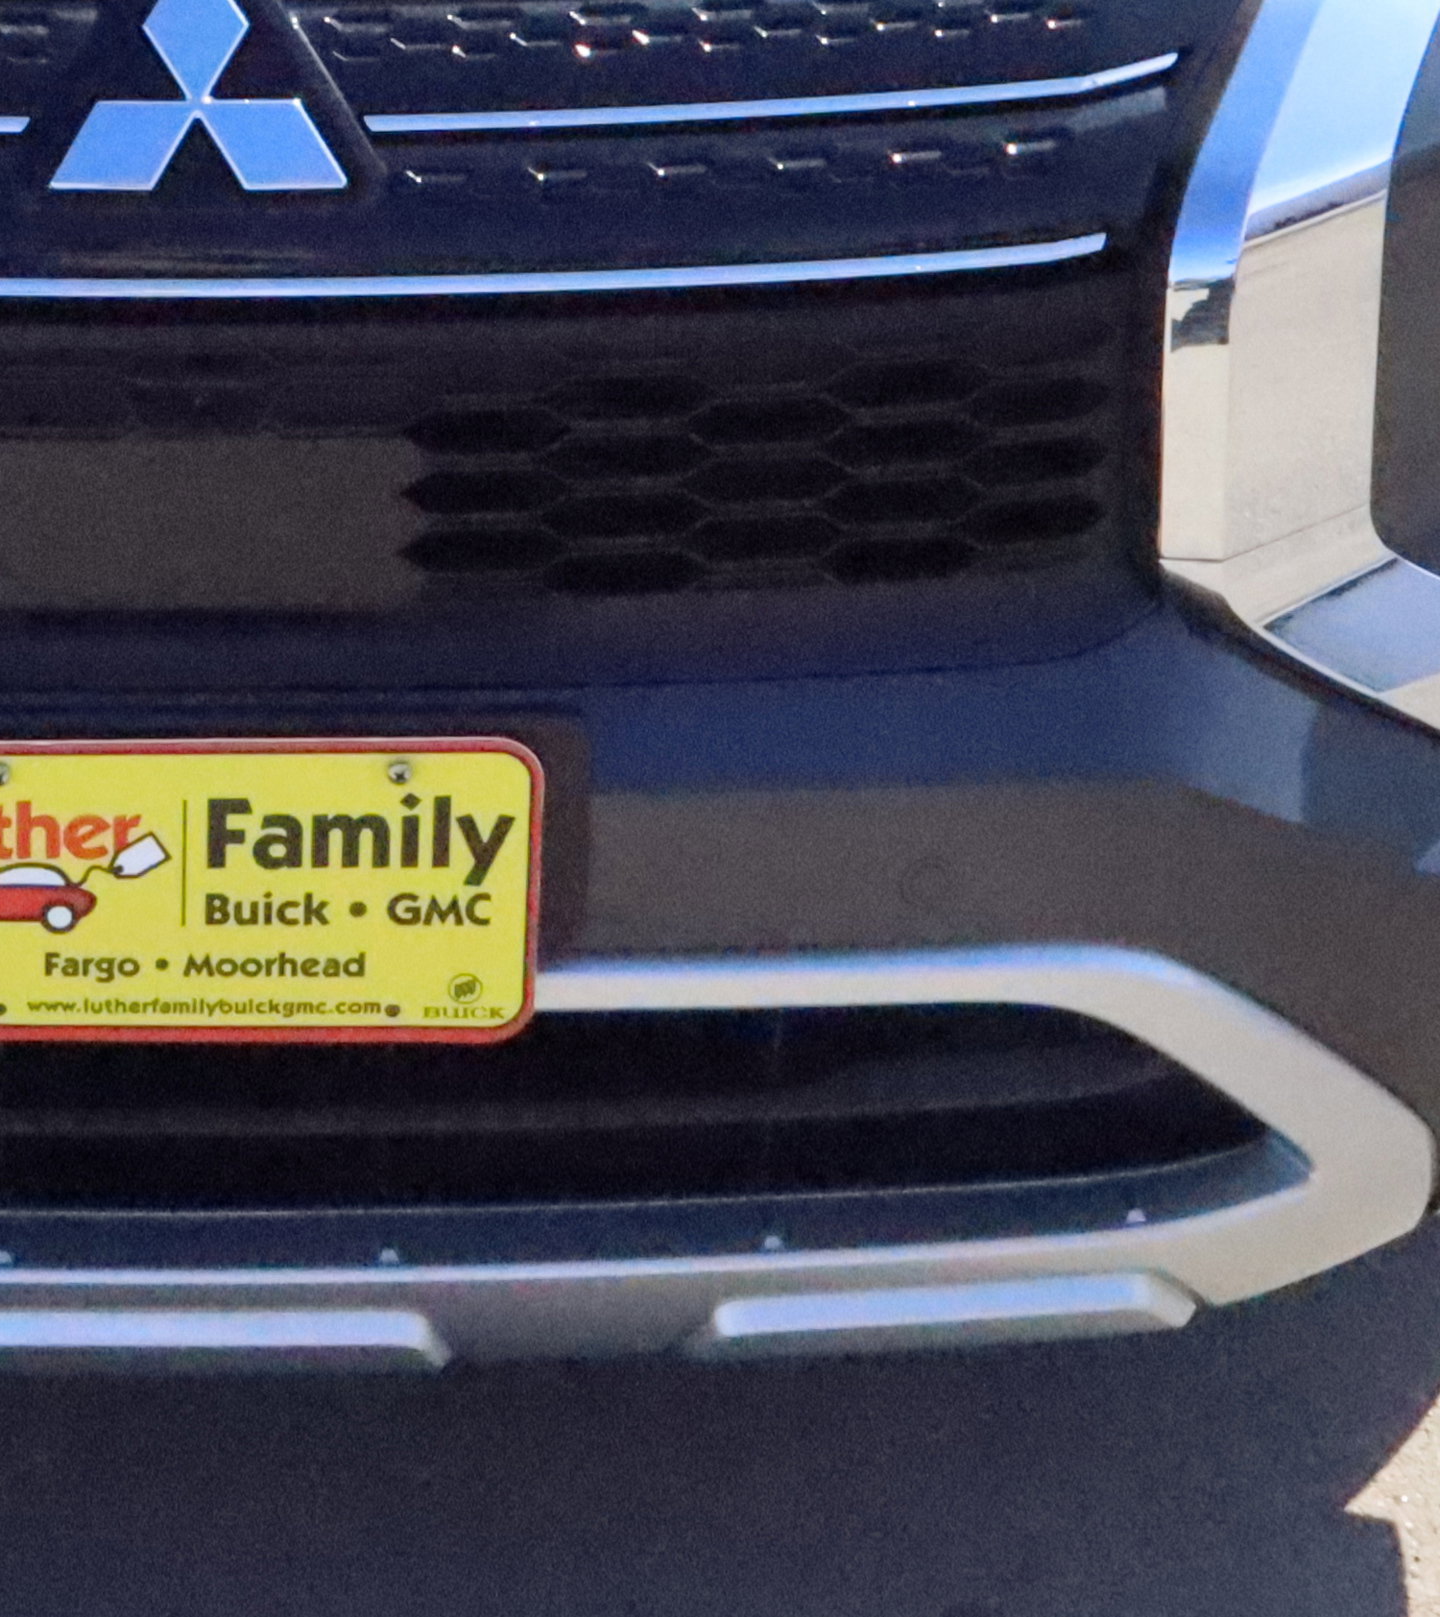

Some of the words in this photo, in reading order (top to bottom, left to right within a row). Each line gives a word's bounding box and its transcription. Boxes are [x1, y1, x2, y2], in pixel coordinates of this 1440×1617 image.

[206, 793, 515, 886] Family
[205, 892, 331, 927] Buick
[387, 892, 492, 927] GMC
[43, 951, 141, 984] Fargo
[183, 951, 366, 979] Moorhead
[26, 997, 382, 1017] www.lutherfamilybuickgmc.com
